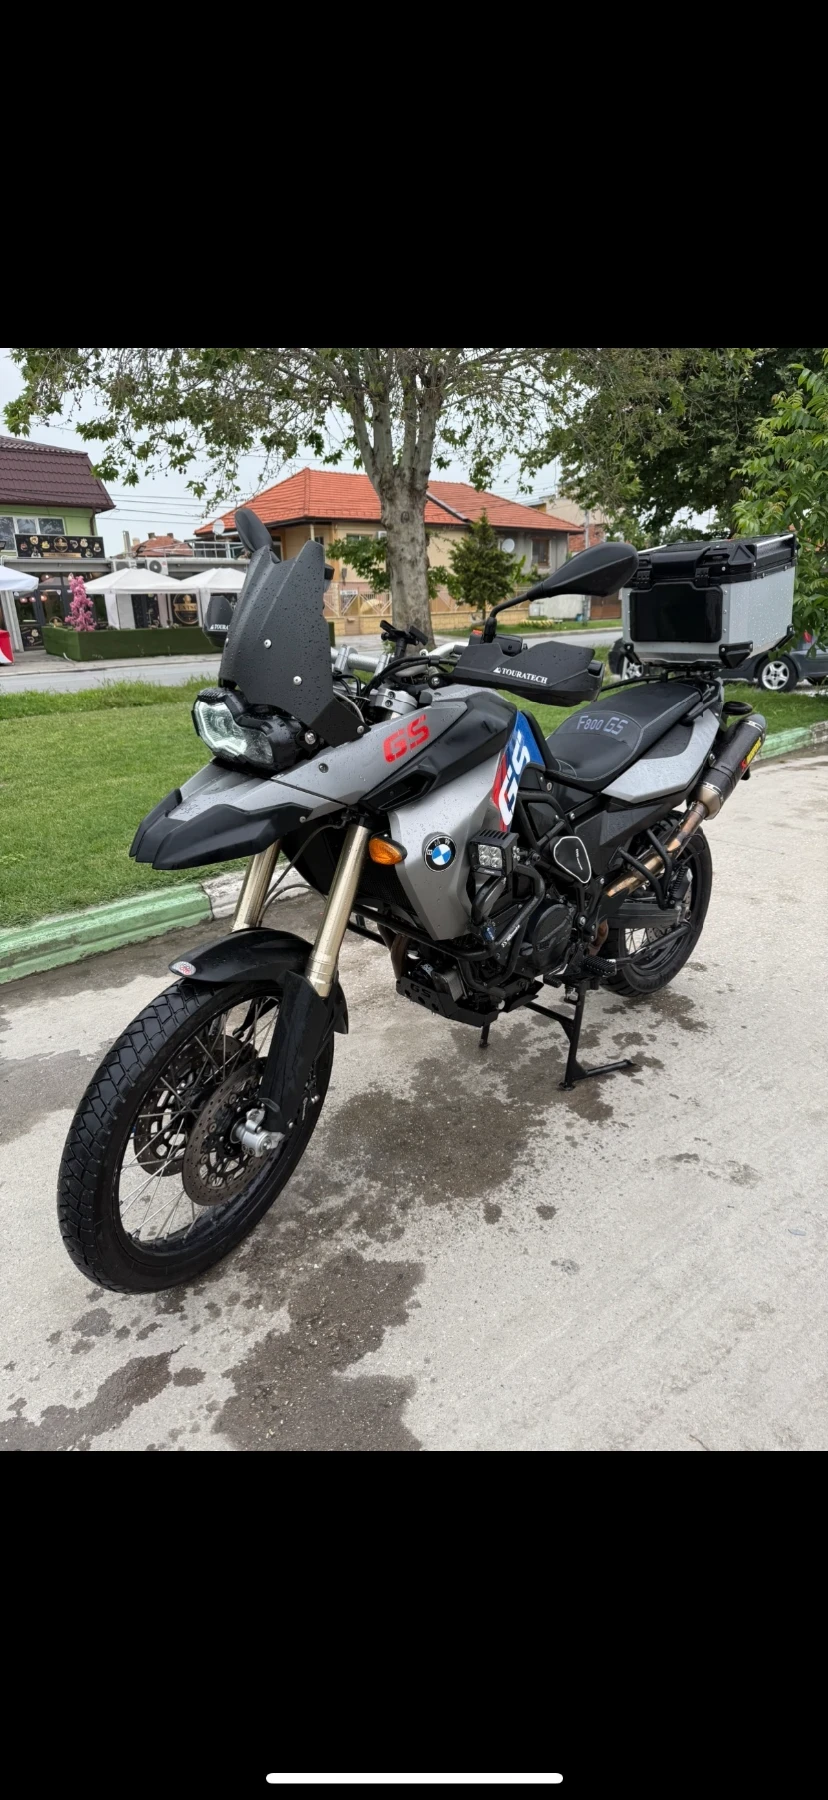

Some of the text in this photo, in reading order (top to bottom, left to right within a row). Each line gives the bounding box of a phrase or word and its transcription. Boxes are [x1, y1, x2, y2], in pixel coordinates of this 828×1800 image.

[502, 667, 548, 684] TOURATECH
[383, 714, 430, 763] GS
[576, 715, 629, 735] F800 GS
[498, 729, 531, 826] GS
